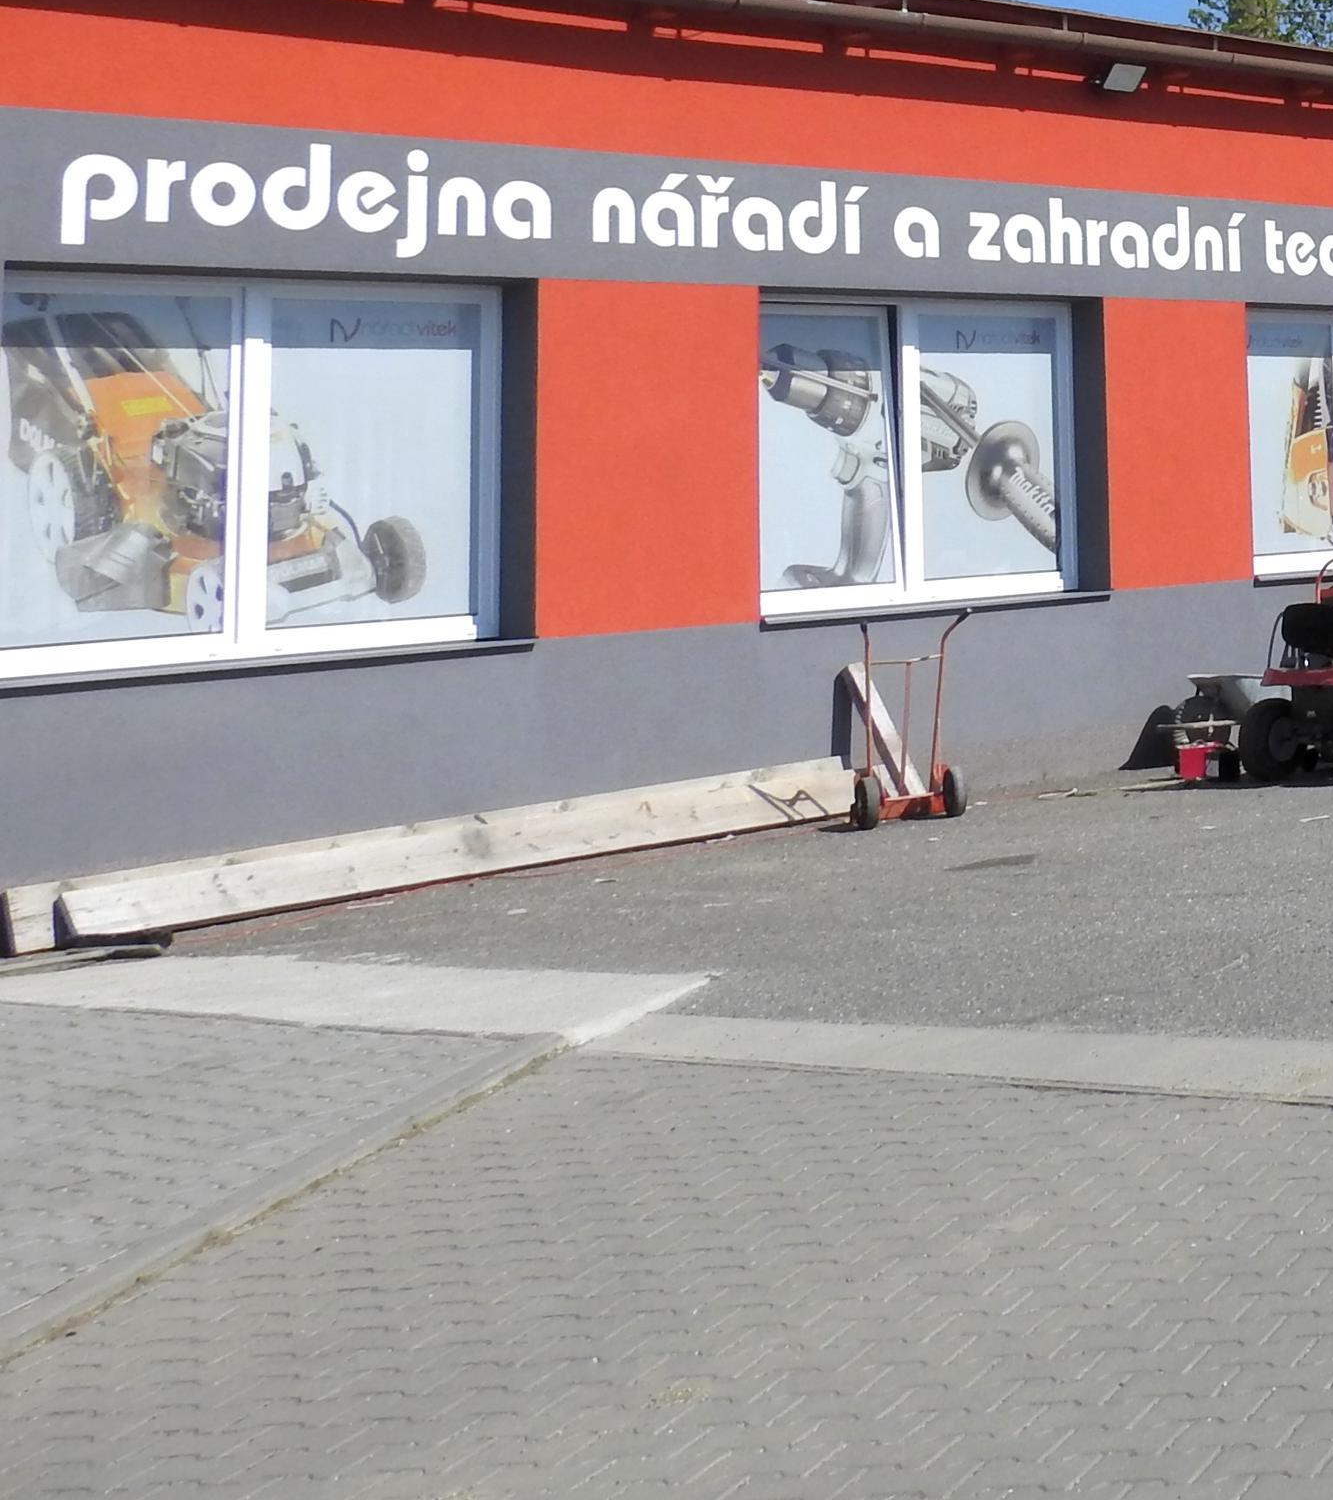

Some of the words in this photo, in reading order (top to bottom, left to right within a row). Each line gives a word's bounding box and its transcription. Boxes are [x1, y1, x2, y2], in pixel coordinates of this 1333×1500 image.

[58, 143, 553, 259] prodejna
[591, 173, 870, 256] nářadí
[892, 205, 941, 259] a
[966, 197, 1246, 273] zahradní
